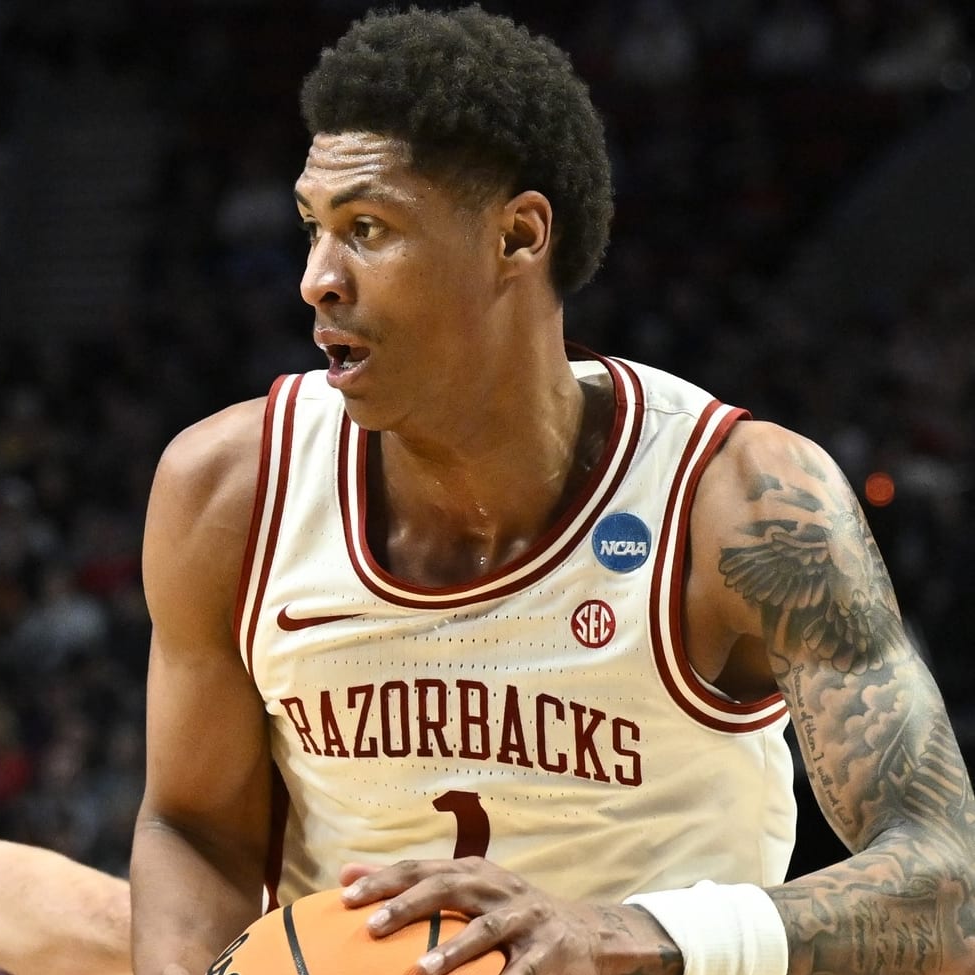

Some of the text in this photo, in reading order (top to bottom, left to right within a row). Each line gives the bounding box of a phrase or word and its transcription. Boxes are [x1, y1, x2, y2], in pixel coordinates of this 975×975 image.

[600, 540, 647, 556] NCAA
[576, 604, 612, 644] SEC
[281, 678, 643, 787] RAZORBACKS
